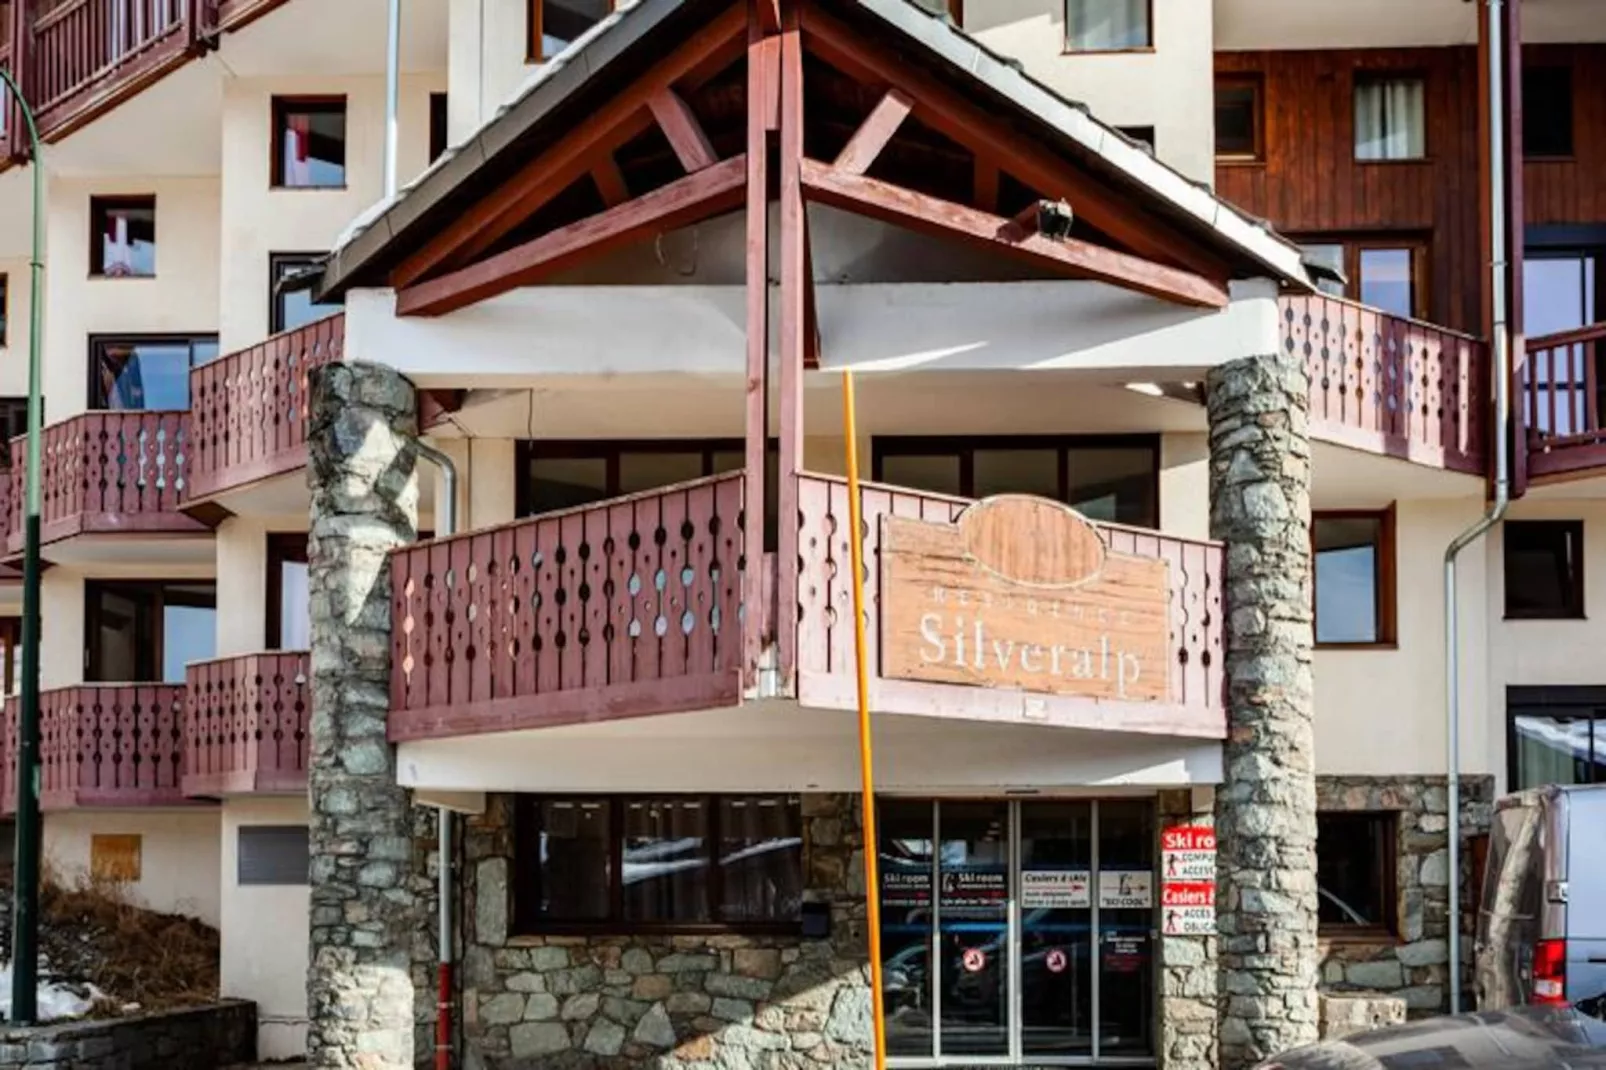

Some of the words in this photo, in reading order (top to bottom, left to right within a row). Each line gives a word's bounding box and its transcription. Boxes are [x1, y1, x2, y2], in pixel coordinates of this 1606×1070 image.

[919, 612, 1141, 699] Silveralp
[1165, 832, 1192, 848] Ski
[958, 873, 975, 882] Ski
[977, 874, 1003, 882] room
